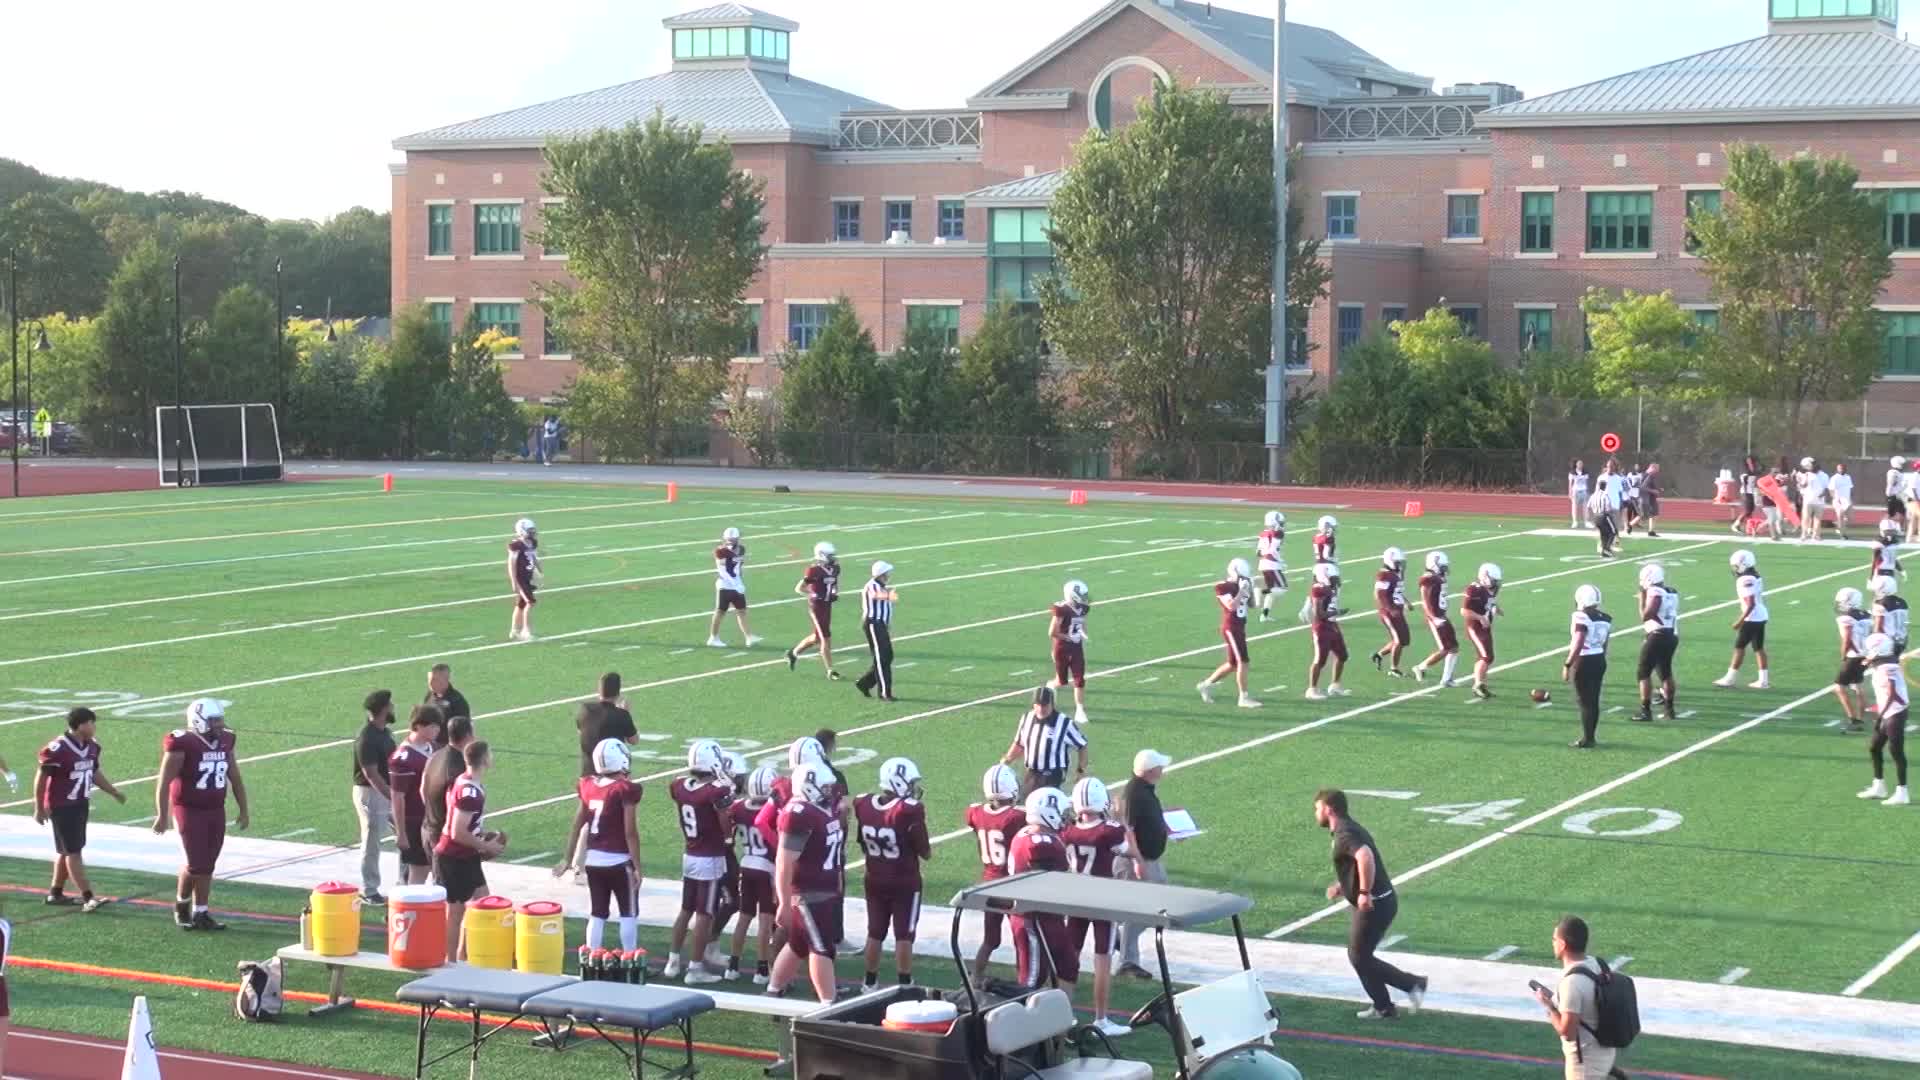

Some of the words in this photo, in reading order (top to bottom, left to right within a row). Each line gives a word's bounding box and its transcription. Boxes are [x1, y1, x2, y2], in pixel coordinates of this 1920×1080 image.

[196, 761, 228, 789] 78
[588, 800, 604, 834] 7
[682, 804, 698, 838] 9
[862, 825, 900, 859] 63
[972, 828, 1005, 866] 16
